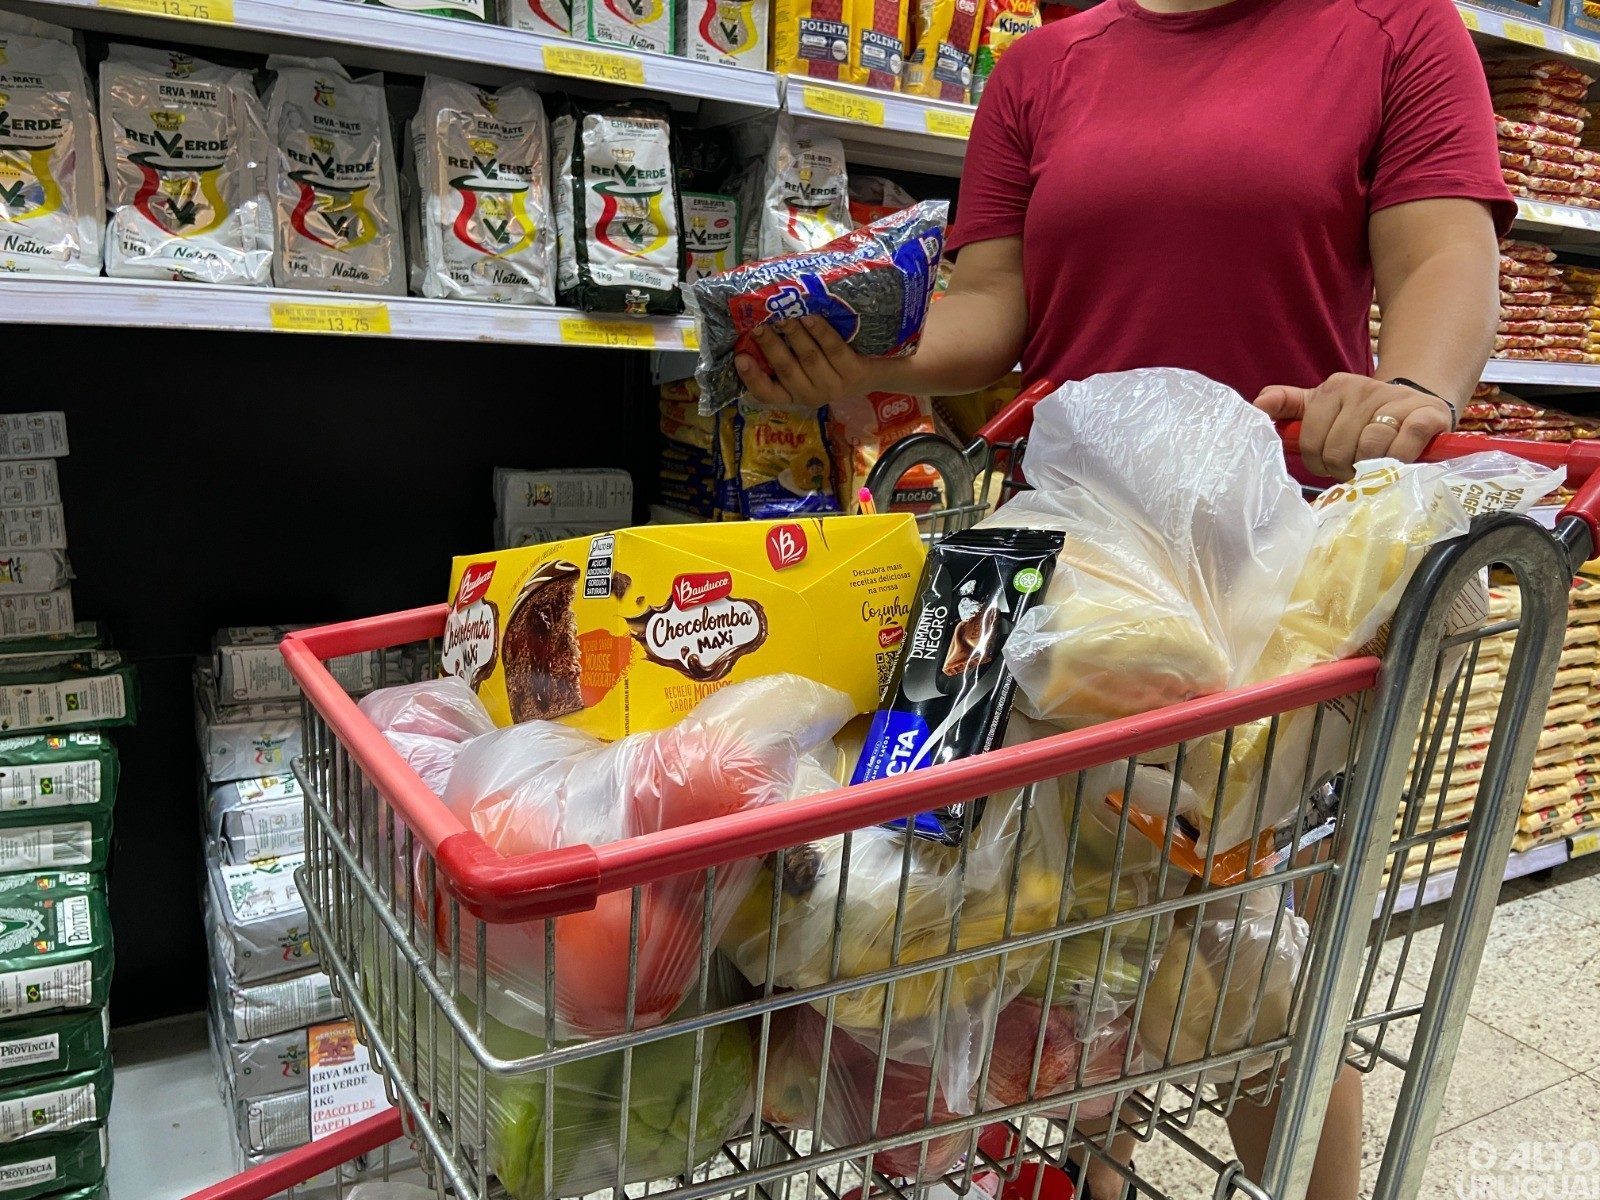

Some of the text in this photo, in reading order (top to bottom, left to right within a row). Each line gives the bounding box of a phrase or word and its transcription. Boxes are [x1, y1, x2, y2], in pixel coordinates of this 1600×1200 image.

[162, 1, 209, 19] 13.75
[800, 20, 849, 36] POLENTA
[862, 31, 903, 50] POLENTA
[939, 44, 973, 64] POLENTA
[590, 64, 627, 80] 24.98
[159, 85, 216, 101] ERVA-MATE
[841, 104, 870, 122] 12.35
[313, 115, 361, 131] ERVA-MATE
[611, 120, 660, 131] ERVA-MATE
[123, 241, 146, 256] 1kg
[332, 262, 369, 280] Nativa
[450, 272, 469, 282] 1kg
[492, 270, 529, 285] Nativa
[328, 317, 369, 332] 13.75
[896, 491, 933, 503] FLOCÃO
[591, 558, 608, 568] AÇÚCAR
[852, 563, 903, 577] Descubra mais
[587, 567, 611, 576] ADICIONADO
[588, 578, 608, 587] GORDURA
[849, 572, 911, 588] receitas deliciosas
[587, 587, 608, 595] SATURADA
[675, 577, 729, 605] Bauducco
[879, 584, 899, 593] nossa
[862, 595, 910, 627] Cozinha
[444, 608, 491, 657] Chocolomba
[653, 606, 752, 648] Chocolomba
[911, 602, 936, 659] DIAMANTE
[923, 605, 948, 660] NEGRO
[586, 653, 611, 671] MOUSSE
[664, 683, 692, 699] RECHEIO
[670, 698, 692, 713] SABOR
[879, 735, 891, 755] LAÇOS
[312, 1069, 340, 1083] ERVA
[313, 1076, 368, 1095] REI VERDE
[314, 1096, 334, 1107] 1KG
[313, 1099, 376, 1122] (PACOTE DE
